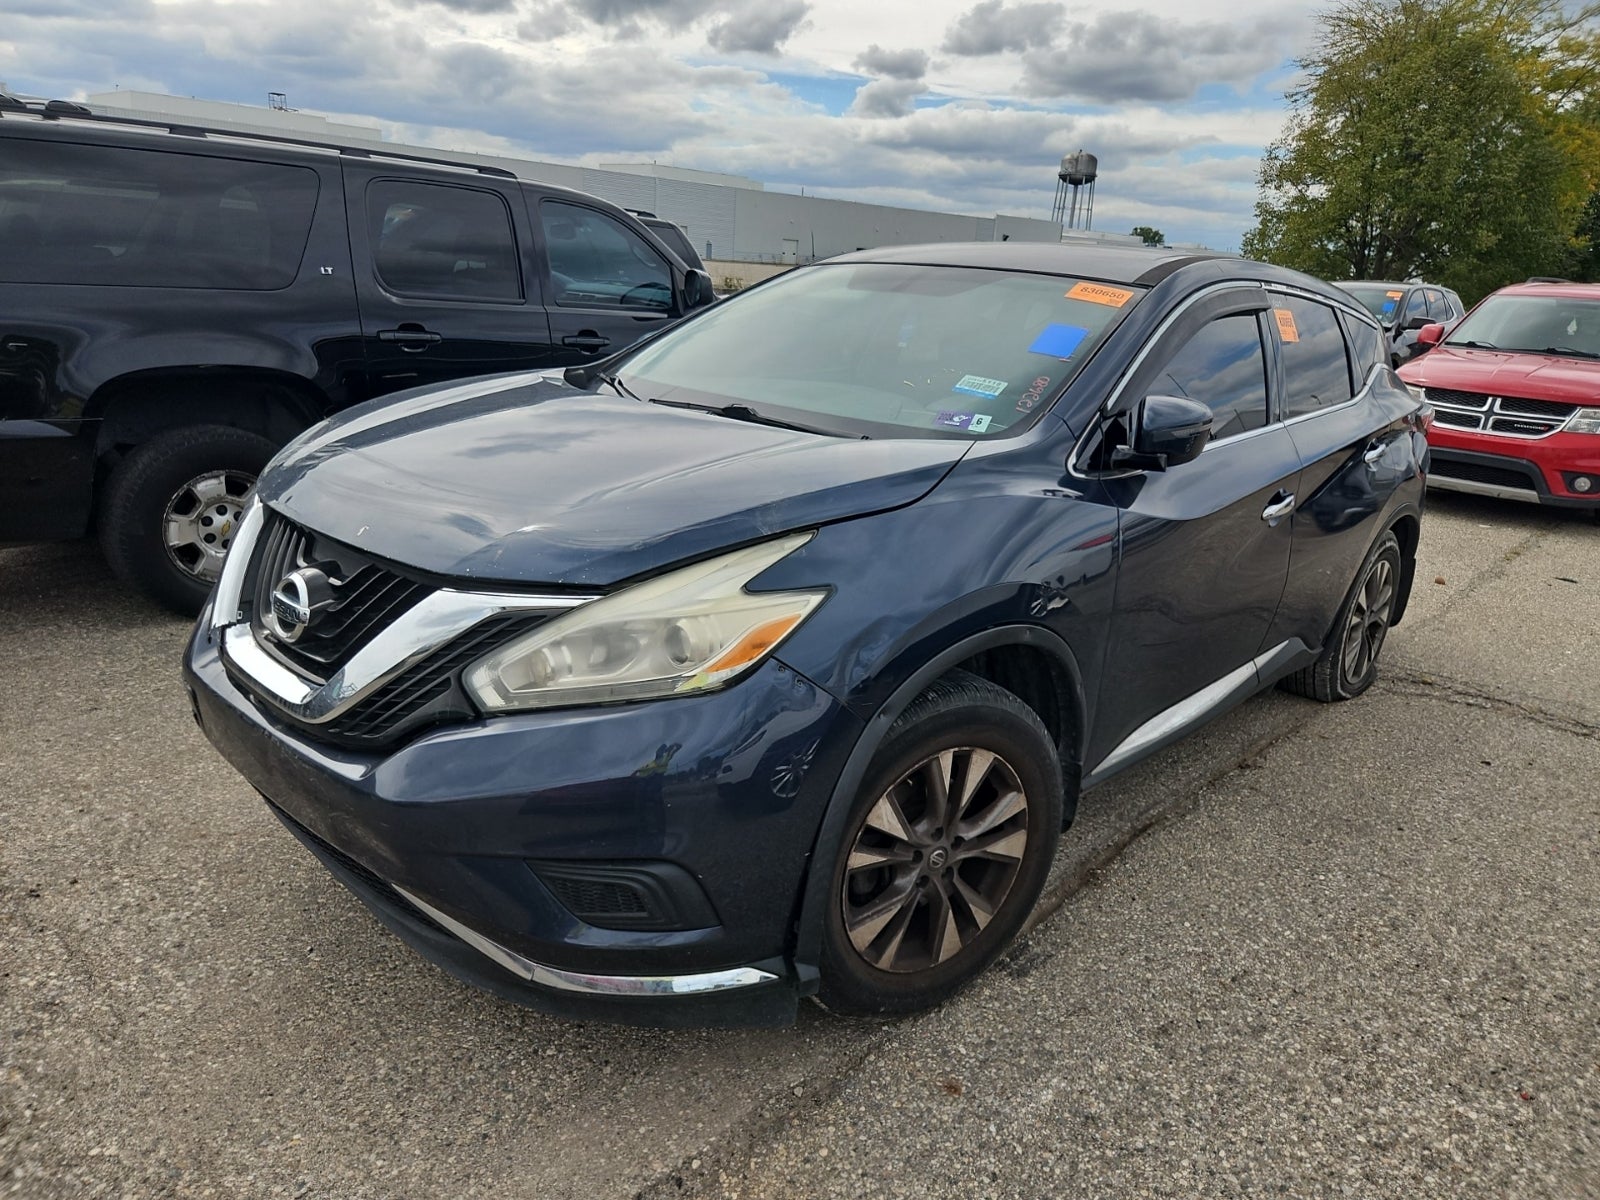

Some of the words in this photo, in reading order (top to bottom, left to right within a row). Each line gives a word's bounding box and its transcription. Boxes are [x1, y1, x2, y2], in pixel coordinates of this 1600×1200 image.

[320, 266, 334, 275] LT
[1080, 286, 1125, 299] 830650
[976, 417, 984, 426] 6
